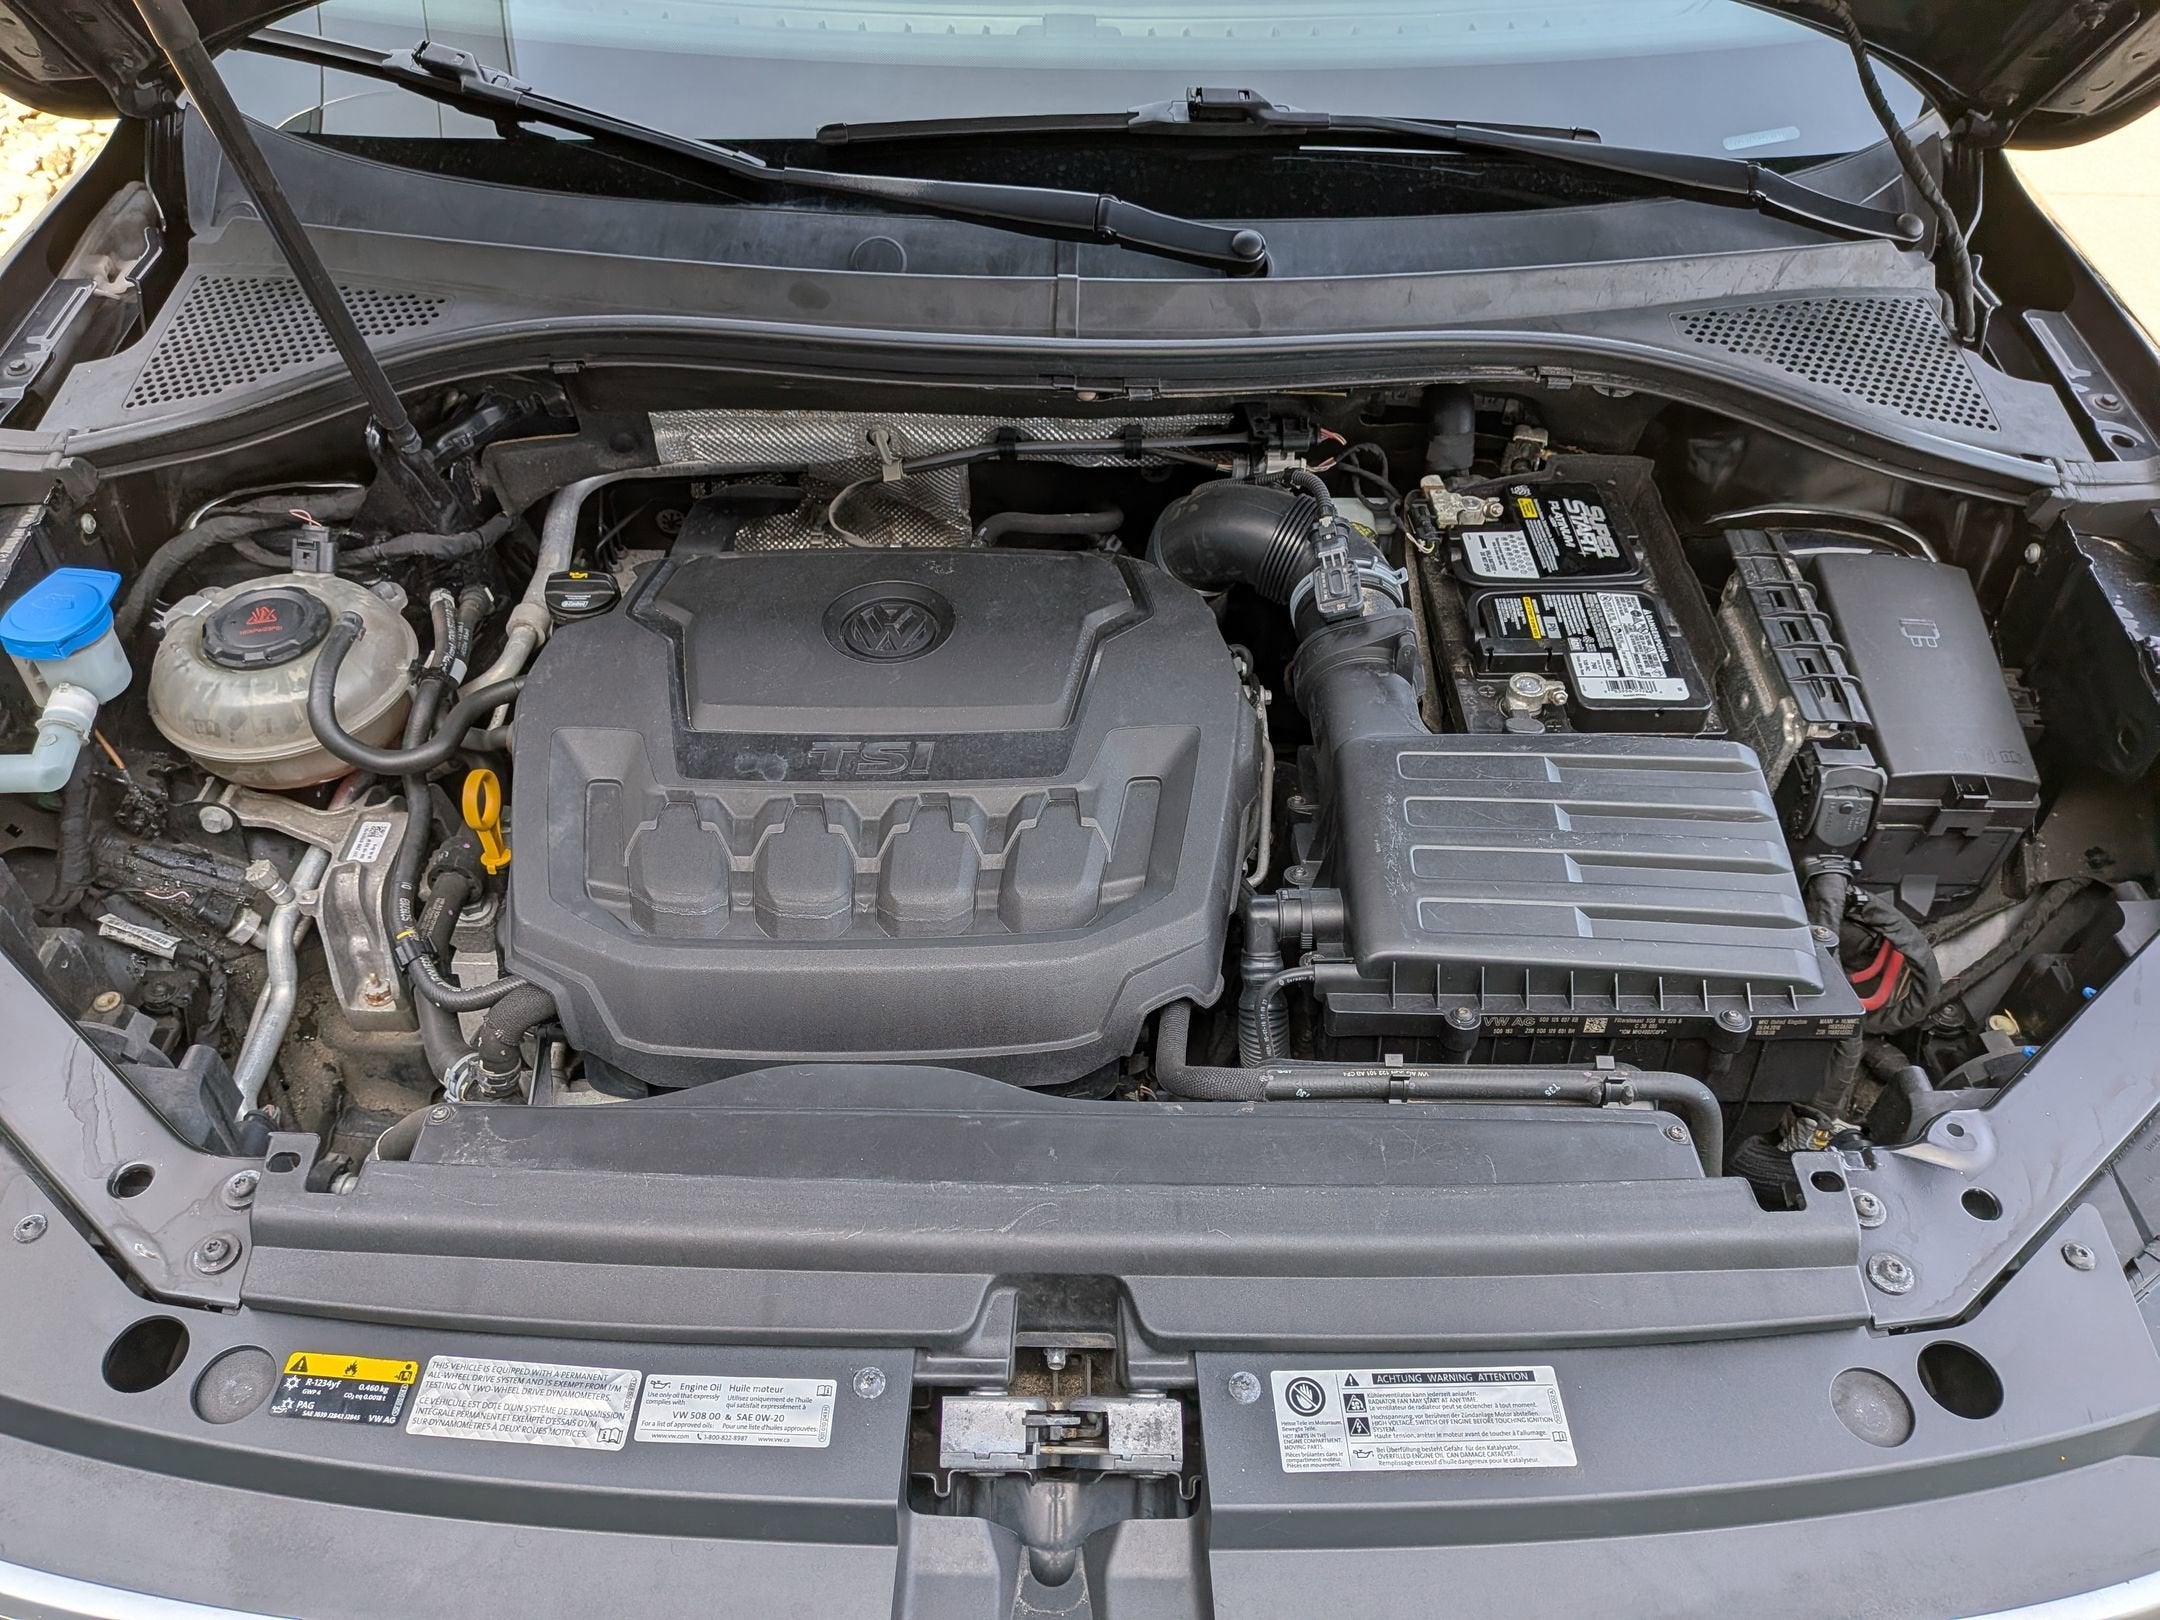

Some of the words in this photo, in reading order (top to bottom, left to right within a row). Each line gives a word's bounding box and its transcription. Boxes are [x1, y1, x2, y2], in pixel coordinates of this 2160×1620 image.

[1548, 500, 1575, 548] PLATINUM
[1563, 498, 1603, 559] START
[1589, 506, 1620, 558] SUPER
[1548, 622, 1556, 632] Pb
[810, 742, 936, 774] TSI
[1484, 1016, 1510, 1026] VW
[1512, 1016, 1536, 1026] AG
[451, 1363, 483, 1372] VEHICLE
[492, 1366, 530, 1375] EQUIPPED
[532, 1369, 552, 1377] WITH
[561, 1371, 608, 1381] PERMANENT
[1377, 1374, 1422, 1383] ACHTUNG
[1427, 1373, 1472, 1382] WARNING
[1478, 1372, 1528, 1381] ATTENTION
[305, 1378, 342, 1390] R-1234yf
[359, 1384, 379, 1392] 0.460
[380, 1385, 389, 1394] kg
[428, 1372, 472, 1381] ALL-WHEEL
[497, 1377, 524, 1385] SYSTEM
[554, 1381, 582, 1389] EXEMPT
[680, 1383, 708, 1392] Engine
[729, 1384, 752, 1393] Huile
[753, 1385, 784, 1393] moteur
[425, 1381, 456, 1389] TESTING
[473, 1384, 519, 1394] TWO-WHEEL
[521, 1388, 544, 1396] DRIVE
[546, 1390, 611, 1401] DYNAMOMETERS.
[297, 1401, 315, 1409] PAG
[503, 1403, 523, 1411] D'UN
[570, 1408, 625, 1419] TRANSMISSION
[368, 1414, 381, 1423] VW
[456, 1410, 501, 1420] PERMANENT
[512, 1414, 544, 1423] EXEMPTÉ
[546, 1417, 576, 1426] D'ESSAIS
[755, 1414, 785, 1422] 0W-20
[499, 1424, 520, 1432] DEUX
[522, 1425, 547, 1434] ROUES
